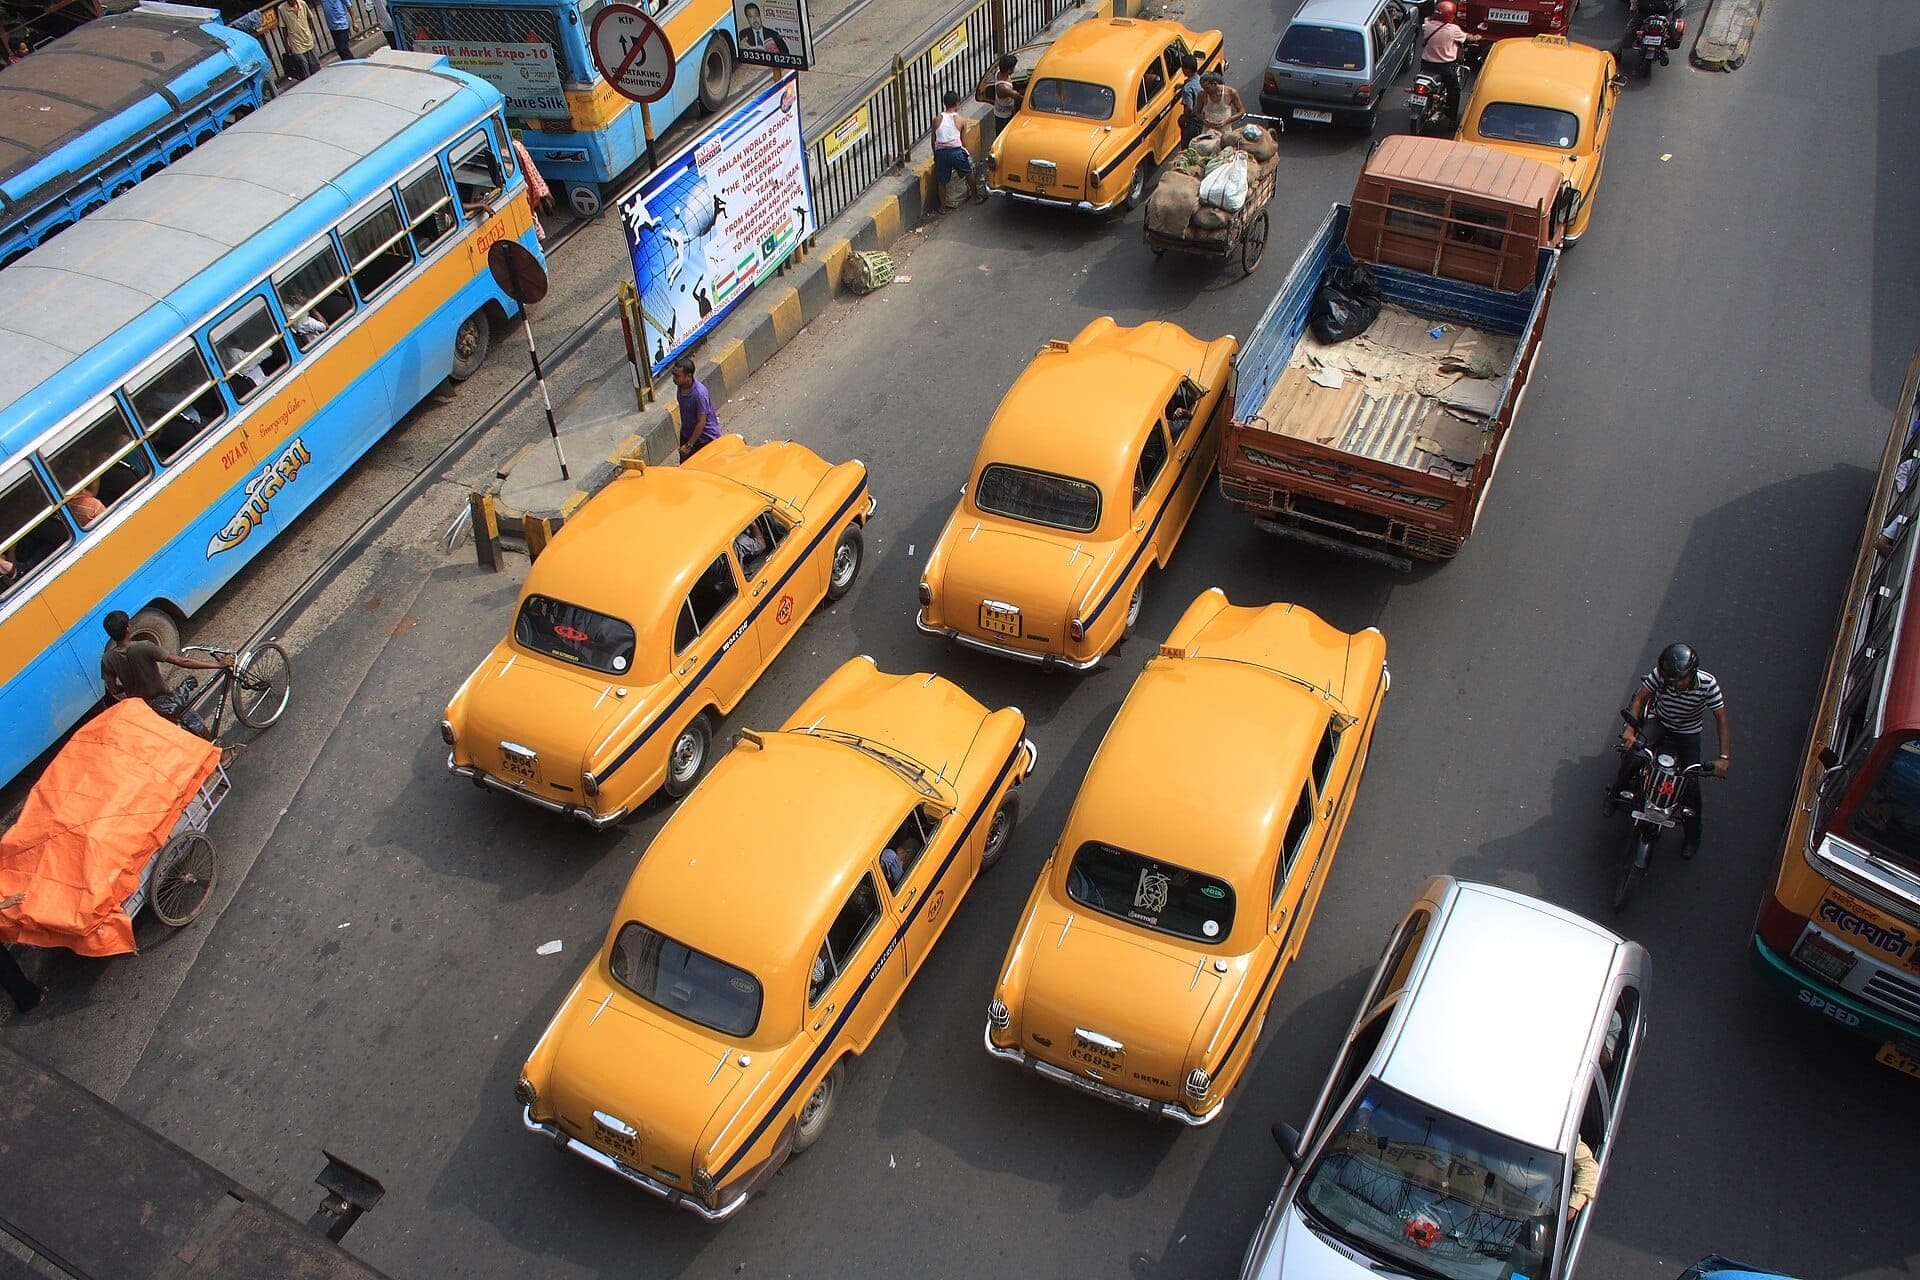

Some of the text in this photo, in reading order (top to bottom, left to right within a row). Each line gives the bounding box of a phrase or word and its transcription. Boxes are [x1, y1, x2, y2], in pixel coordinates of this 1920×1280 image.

[431, 45, 548, 61] Silk Mark Expo-10
[743, 50, 802, 65] 93310 62733
[1541, 36, 1564, 45] TAXI
[506, 96, 565, 109] Pure Silk
[717, 150, 743, 177] PAILAN
[743, 132, 767, 155] WORLD
[768, 111, 794, 134] SCHOOL
[740, 137, 778, 171] WELCOMES
[725, 180, 740, 196] THE
[742, 136, 793, 182] INTERNATIONAL
[742, 159, 783, 195] VOLLEYBALL
[724, 214, 744, 236] FROM
[785, 163, 800, 182] IRAN
[756, 176, 775, 196] TEAM
[732, 241, 742, 253] TO
[743, 212, 774, 245] INTERACT
[775, 197, 790, 216] WITH
[735, 178, 797, 239] PAKISTAN AND INDIA
[756, 211, 787, 246] STUDENTS
[1797, 988, 1861, 1027] SPEED
[1133, 1072, 1172, 1087] GREWAL
